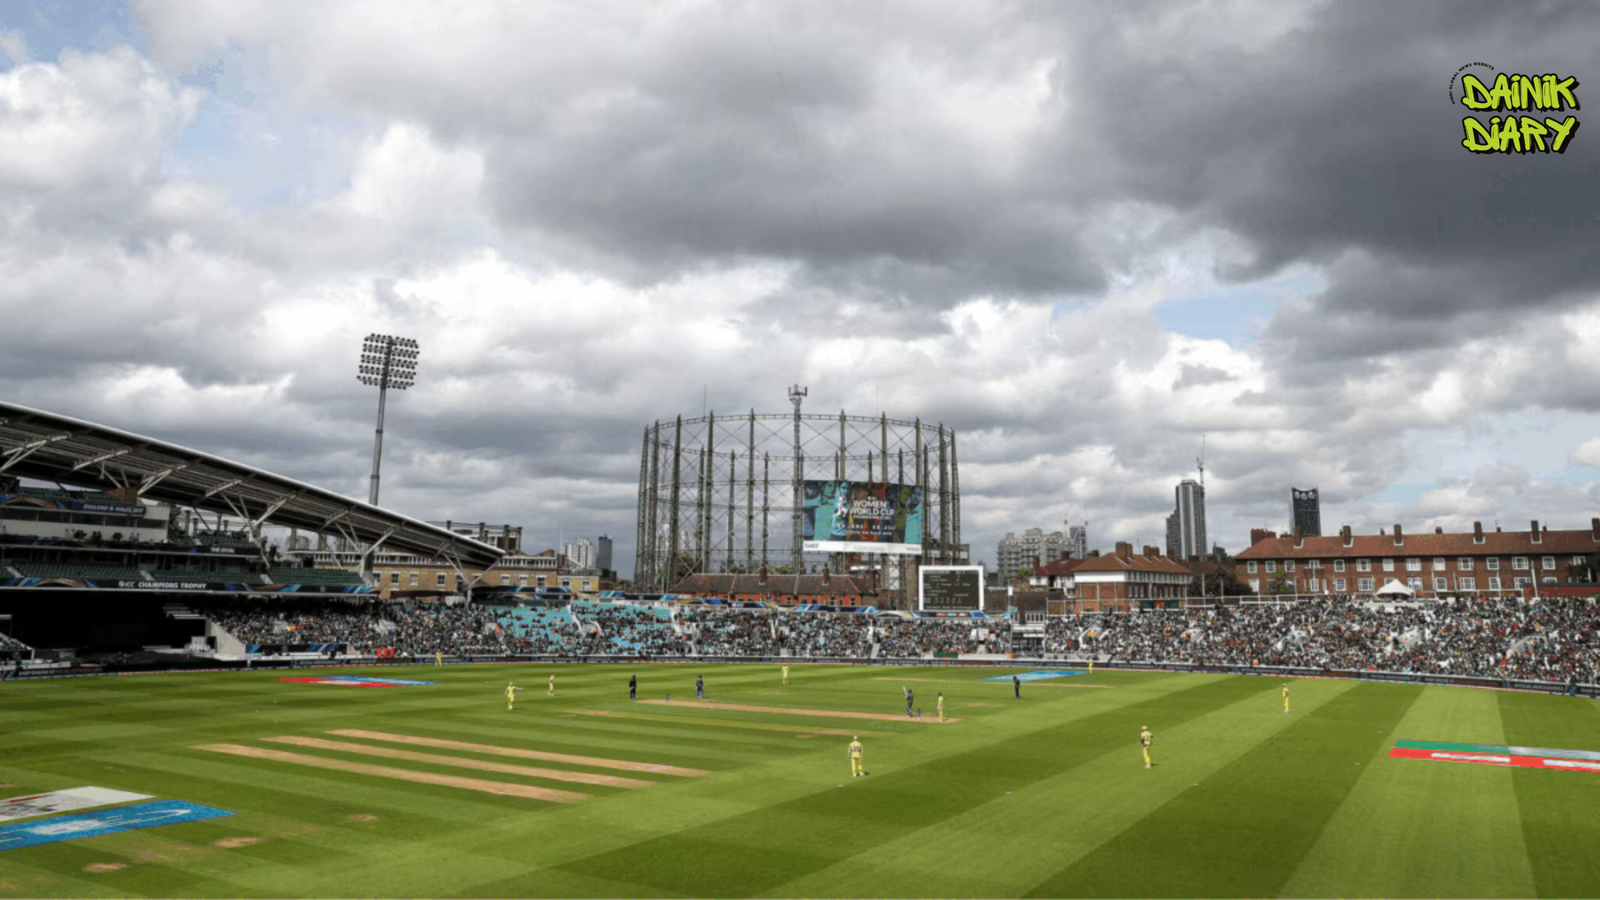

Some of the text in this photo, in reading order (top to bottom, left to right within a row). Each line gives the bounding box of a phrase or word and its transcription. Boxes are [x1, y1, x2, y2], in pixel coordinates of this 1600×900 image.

[850, 507, 895, 516] WORLD CUP
[138, 581, 178, 589] CHAMPIONS
